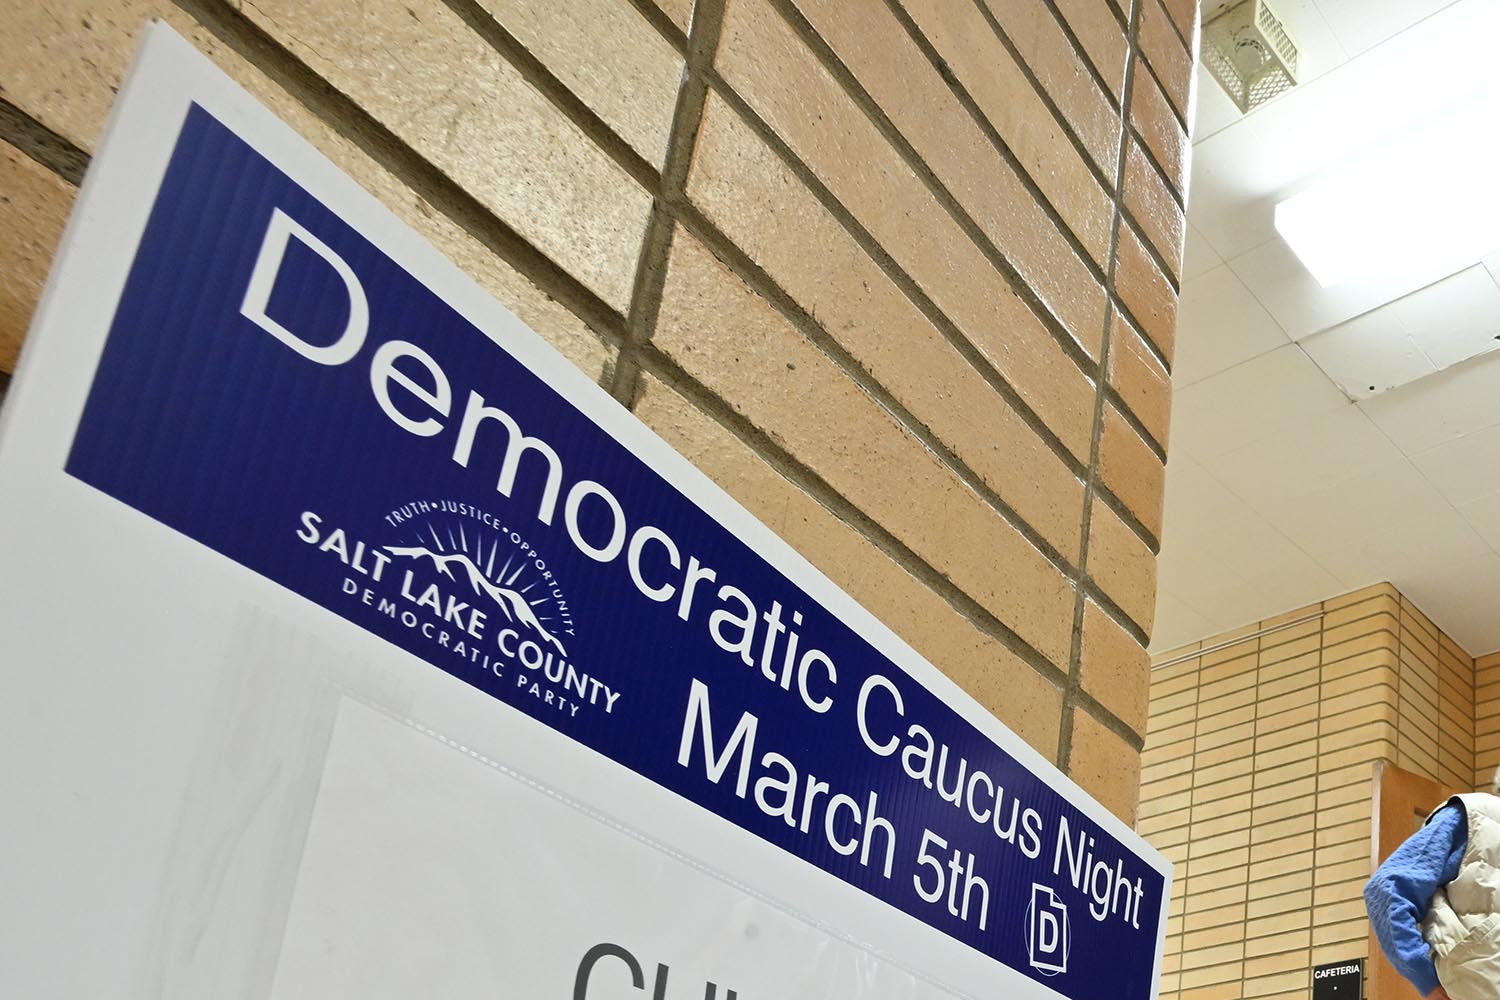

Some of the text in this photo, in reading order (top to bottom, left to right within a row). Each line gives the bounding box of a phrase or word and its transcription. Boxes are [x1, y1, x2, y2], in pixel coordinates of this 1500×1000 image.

[239, 206, 1144, 930] Democratic Caucus Night
[296, 510, 621, 715] SALT LAKE COUNTY
[341, 577, 580, 718] DEMOCRATIC PARTY
[384, 500, 576, 637] TRUTH JUSTICE OPPORTUNITY
[677, 677, 990, 931] March 5th
[1314, 964, 1360, 979] CAFETERIA
